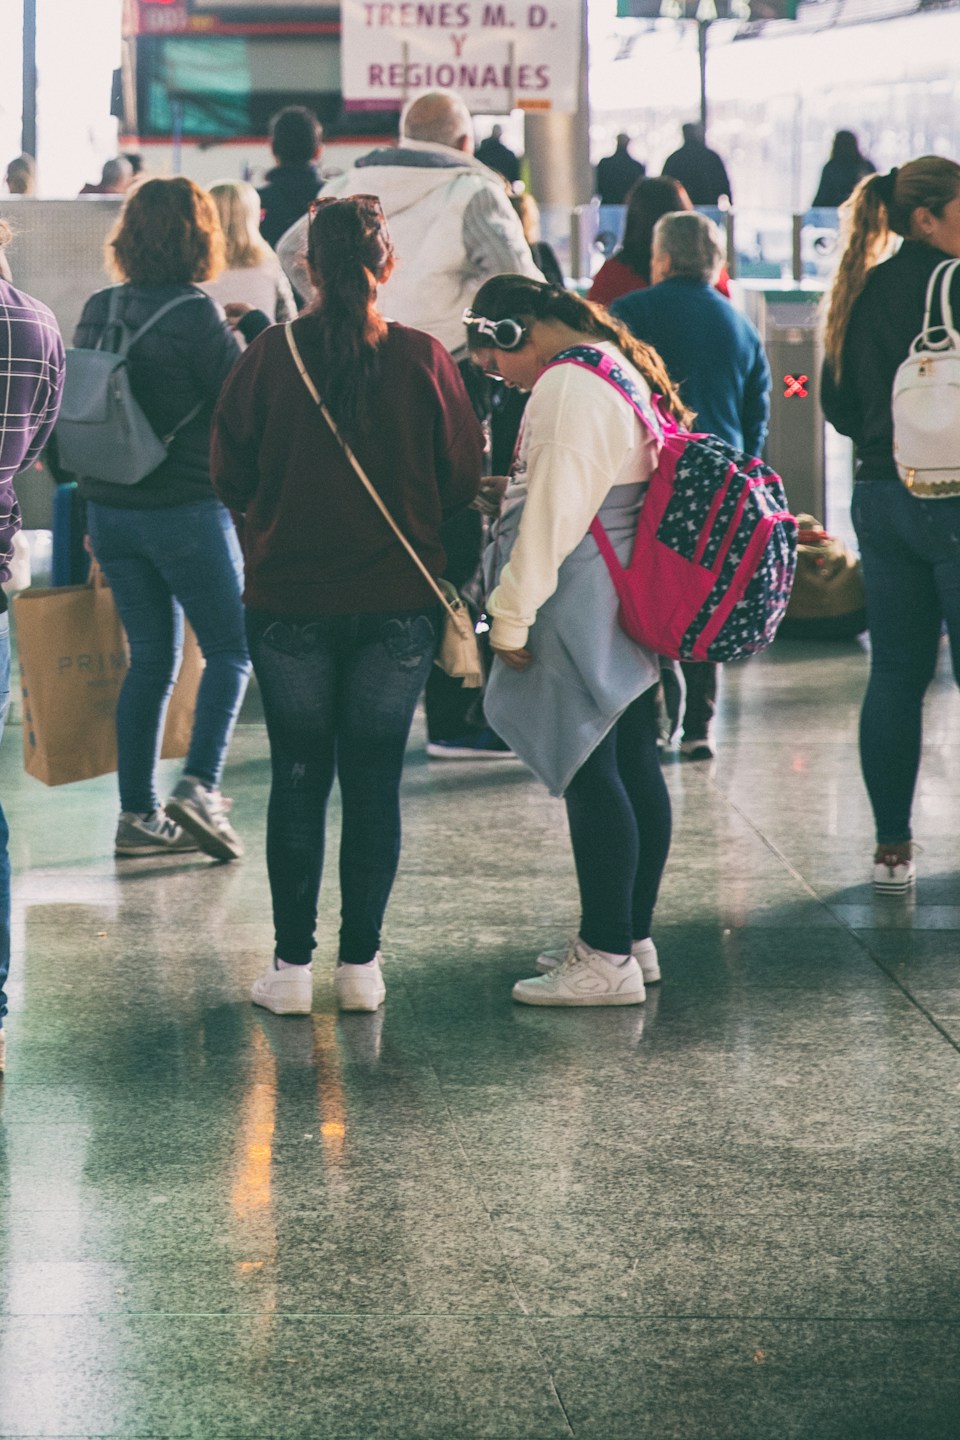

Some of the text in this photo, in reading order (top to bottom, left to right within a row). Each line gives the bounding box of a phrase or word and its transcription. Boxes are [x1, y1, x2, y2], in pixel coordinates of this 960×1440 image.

[363, 2, 558, 30] TRENES M. D.
[450, 33, 467, 58] Y
[367, 62, 551, 89] REGIONALES
